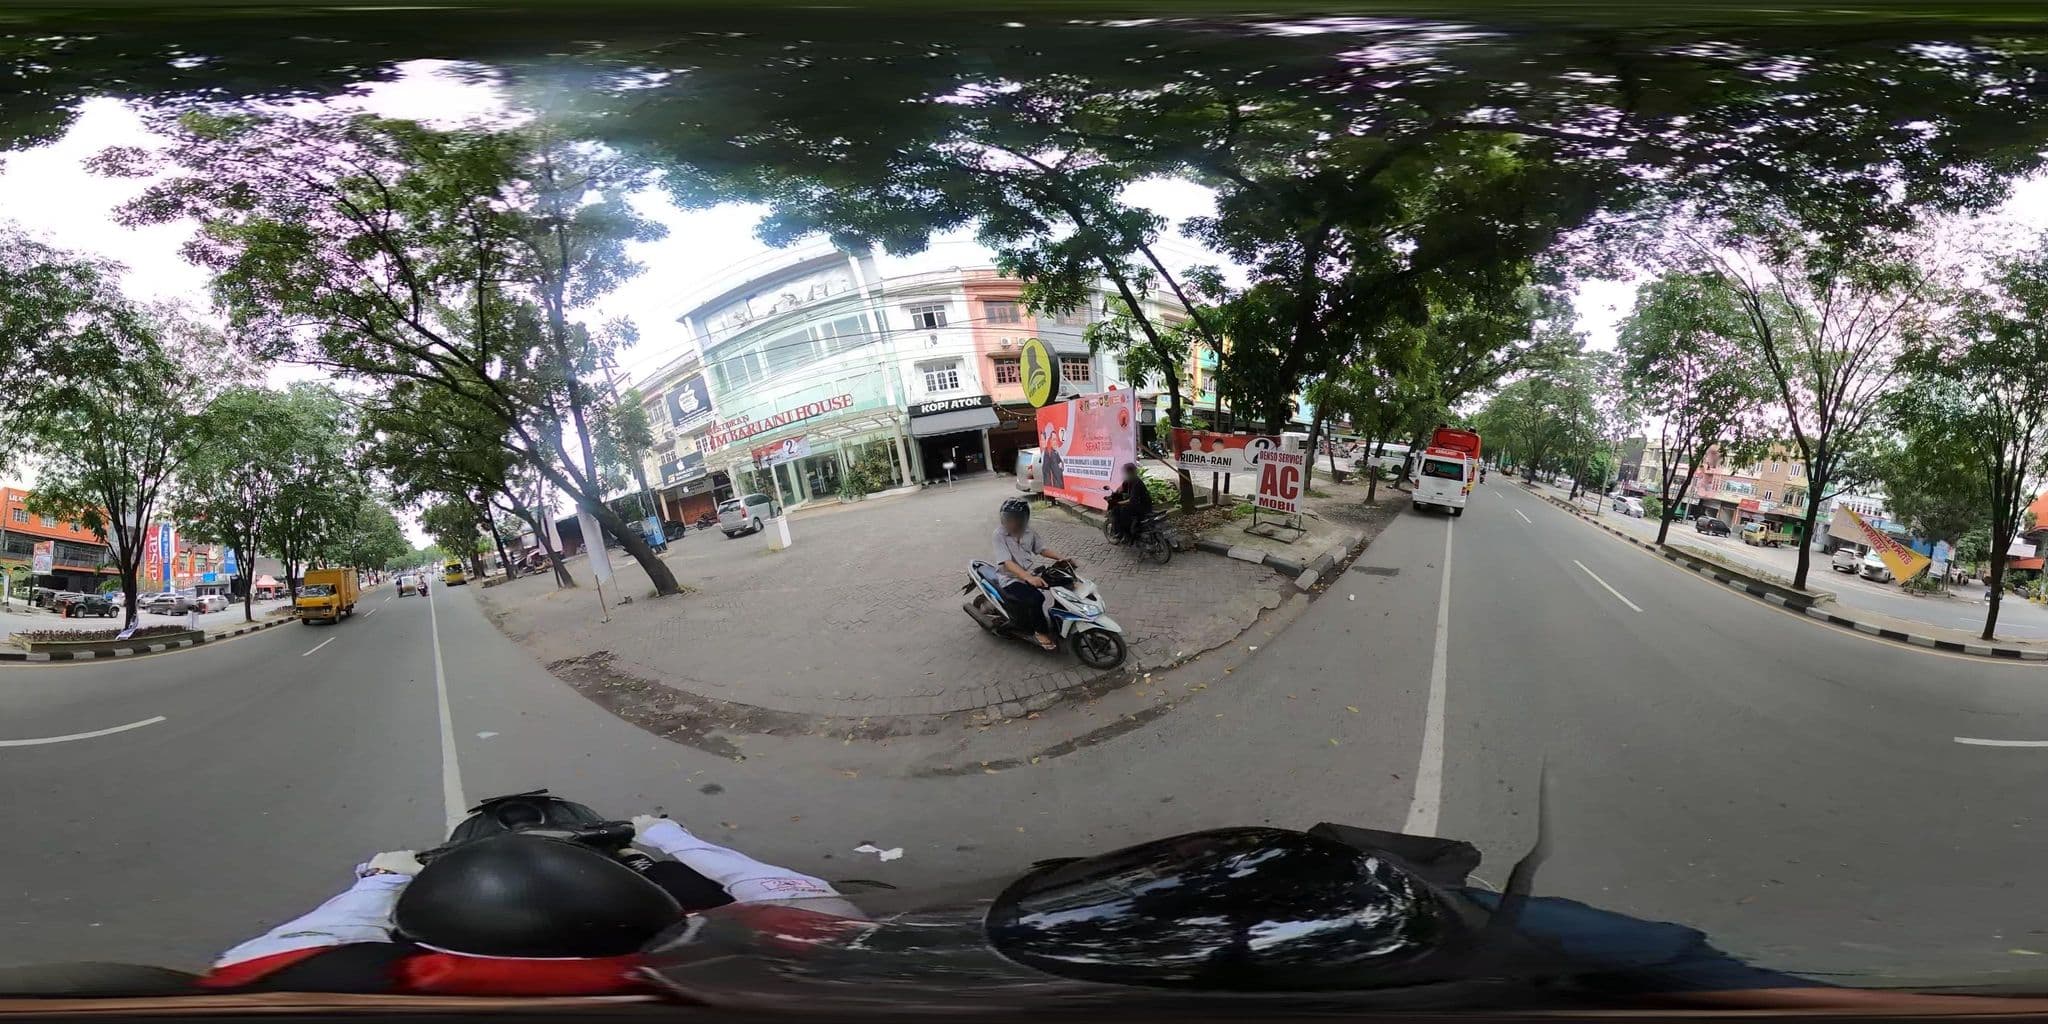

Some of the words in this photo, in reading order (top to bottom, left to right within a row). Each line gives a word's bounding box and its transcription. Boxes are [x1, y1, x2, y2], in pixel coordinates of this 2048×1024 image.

[797, 394, 854, 421] HOUSE
[921, 402, 948, 413] KOPI
[951, 397, 982, 409] ATOK
[786, 440, 794, 455] 2
[1180, 453, 1231, 466] RIDHA-RANI
[1259, 450, 1278, 461] DENSO
[1278, 452, 1303, 465] SERVICE
[1260, 463, 1299, 500] AC
[1259, 497, 1296, 513] MOBIL
[1860, 520, 1887, 553] JADIKAN
